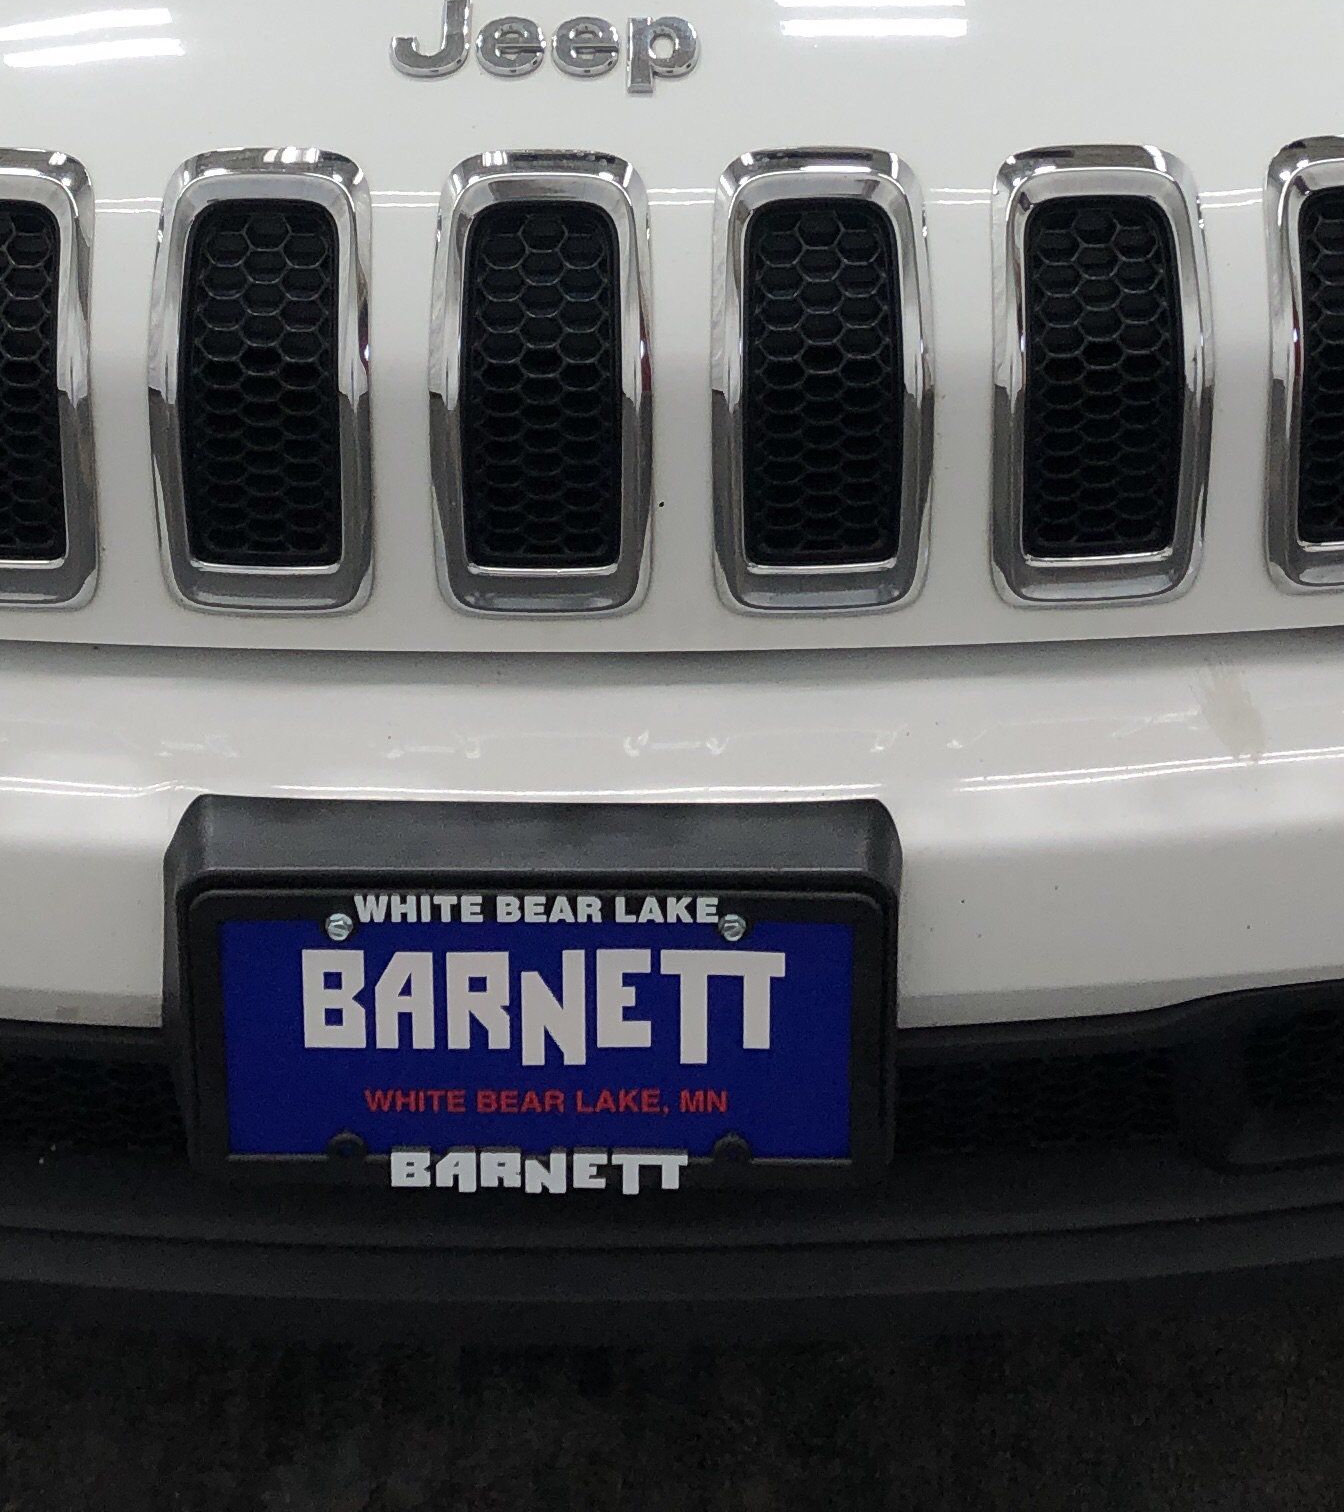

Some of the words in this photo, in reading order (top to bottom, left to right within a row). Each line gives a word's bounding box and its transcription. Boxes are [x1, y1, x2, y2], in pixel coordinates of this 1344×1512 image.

[353, 893, 485, 924] WHITE
[496, 894, 603, 924] BEAR
[613, 895, 720, 925] LAKE
[300, 947, 787, 1067] BARNETT
[364, 1089, 466, 1113] WHITE
[476, 1089, 565, 1113] BEAR
[574, 1089, 670, 1117] LAKE,
[679, 1089, 729, 1113] MN
[389, 1149, 690, 1196] BARNETT
